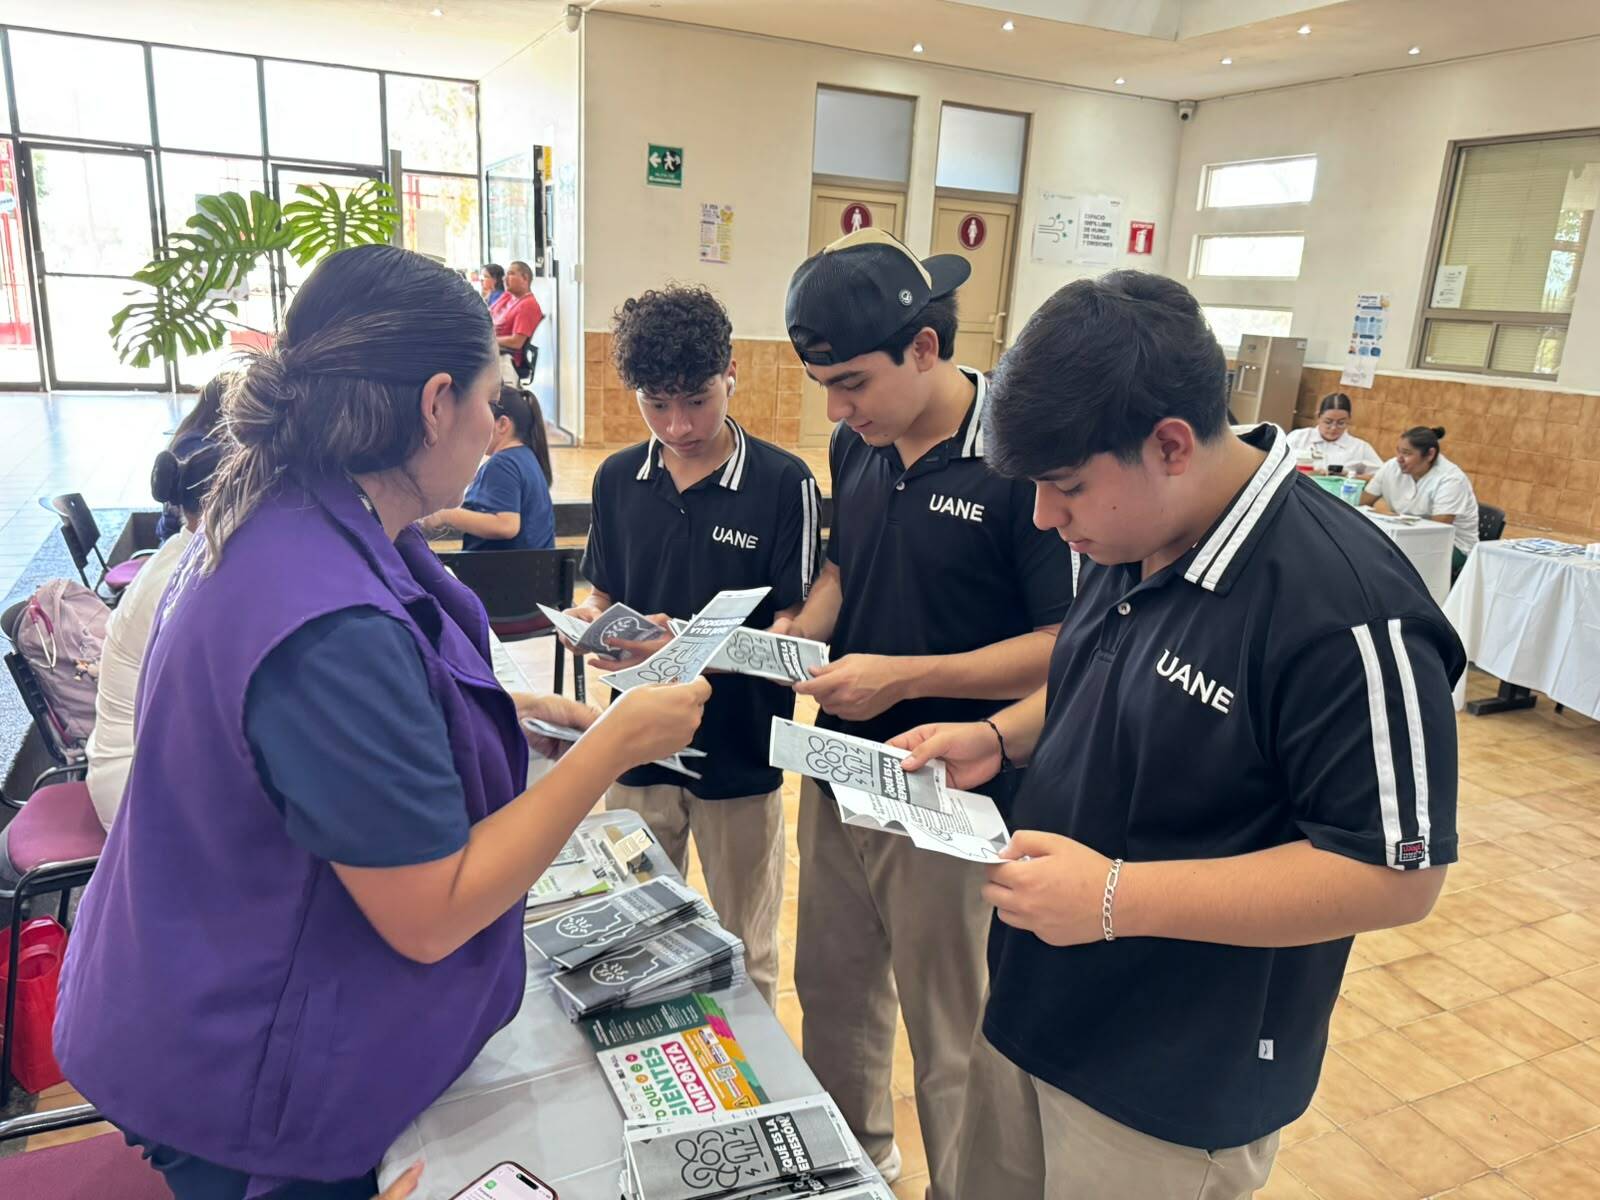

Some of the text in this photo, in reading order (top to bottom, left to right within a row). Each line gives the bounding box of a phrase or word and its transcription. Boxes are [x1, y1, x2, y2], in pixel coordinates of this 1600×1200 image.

[928, 493, 985, 523] UANE
[711, 525, 759, 549] UANE
[1156, 648, 1235, 714] UANE
[640, 1046, 693, 1117] SIENTES
[665, 1042, 714, 1112] IMPORTA
[641, 1083, 662, 1107] QUE
[766, 1118, 780, 1132] LA
[771, 1132, 784, 1144] ES
